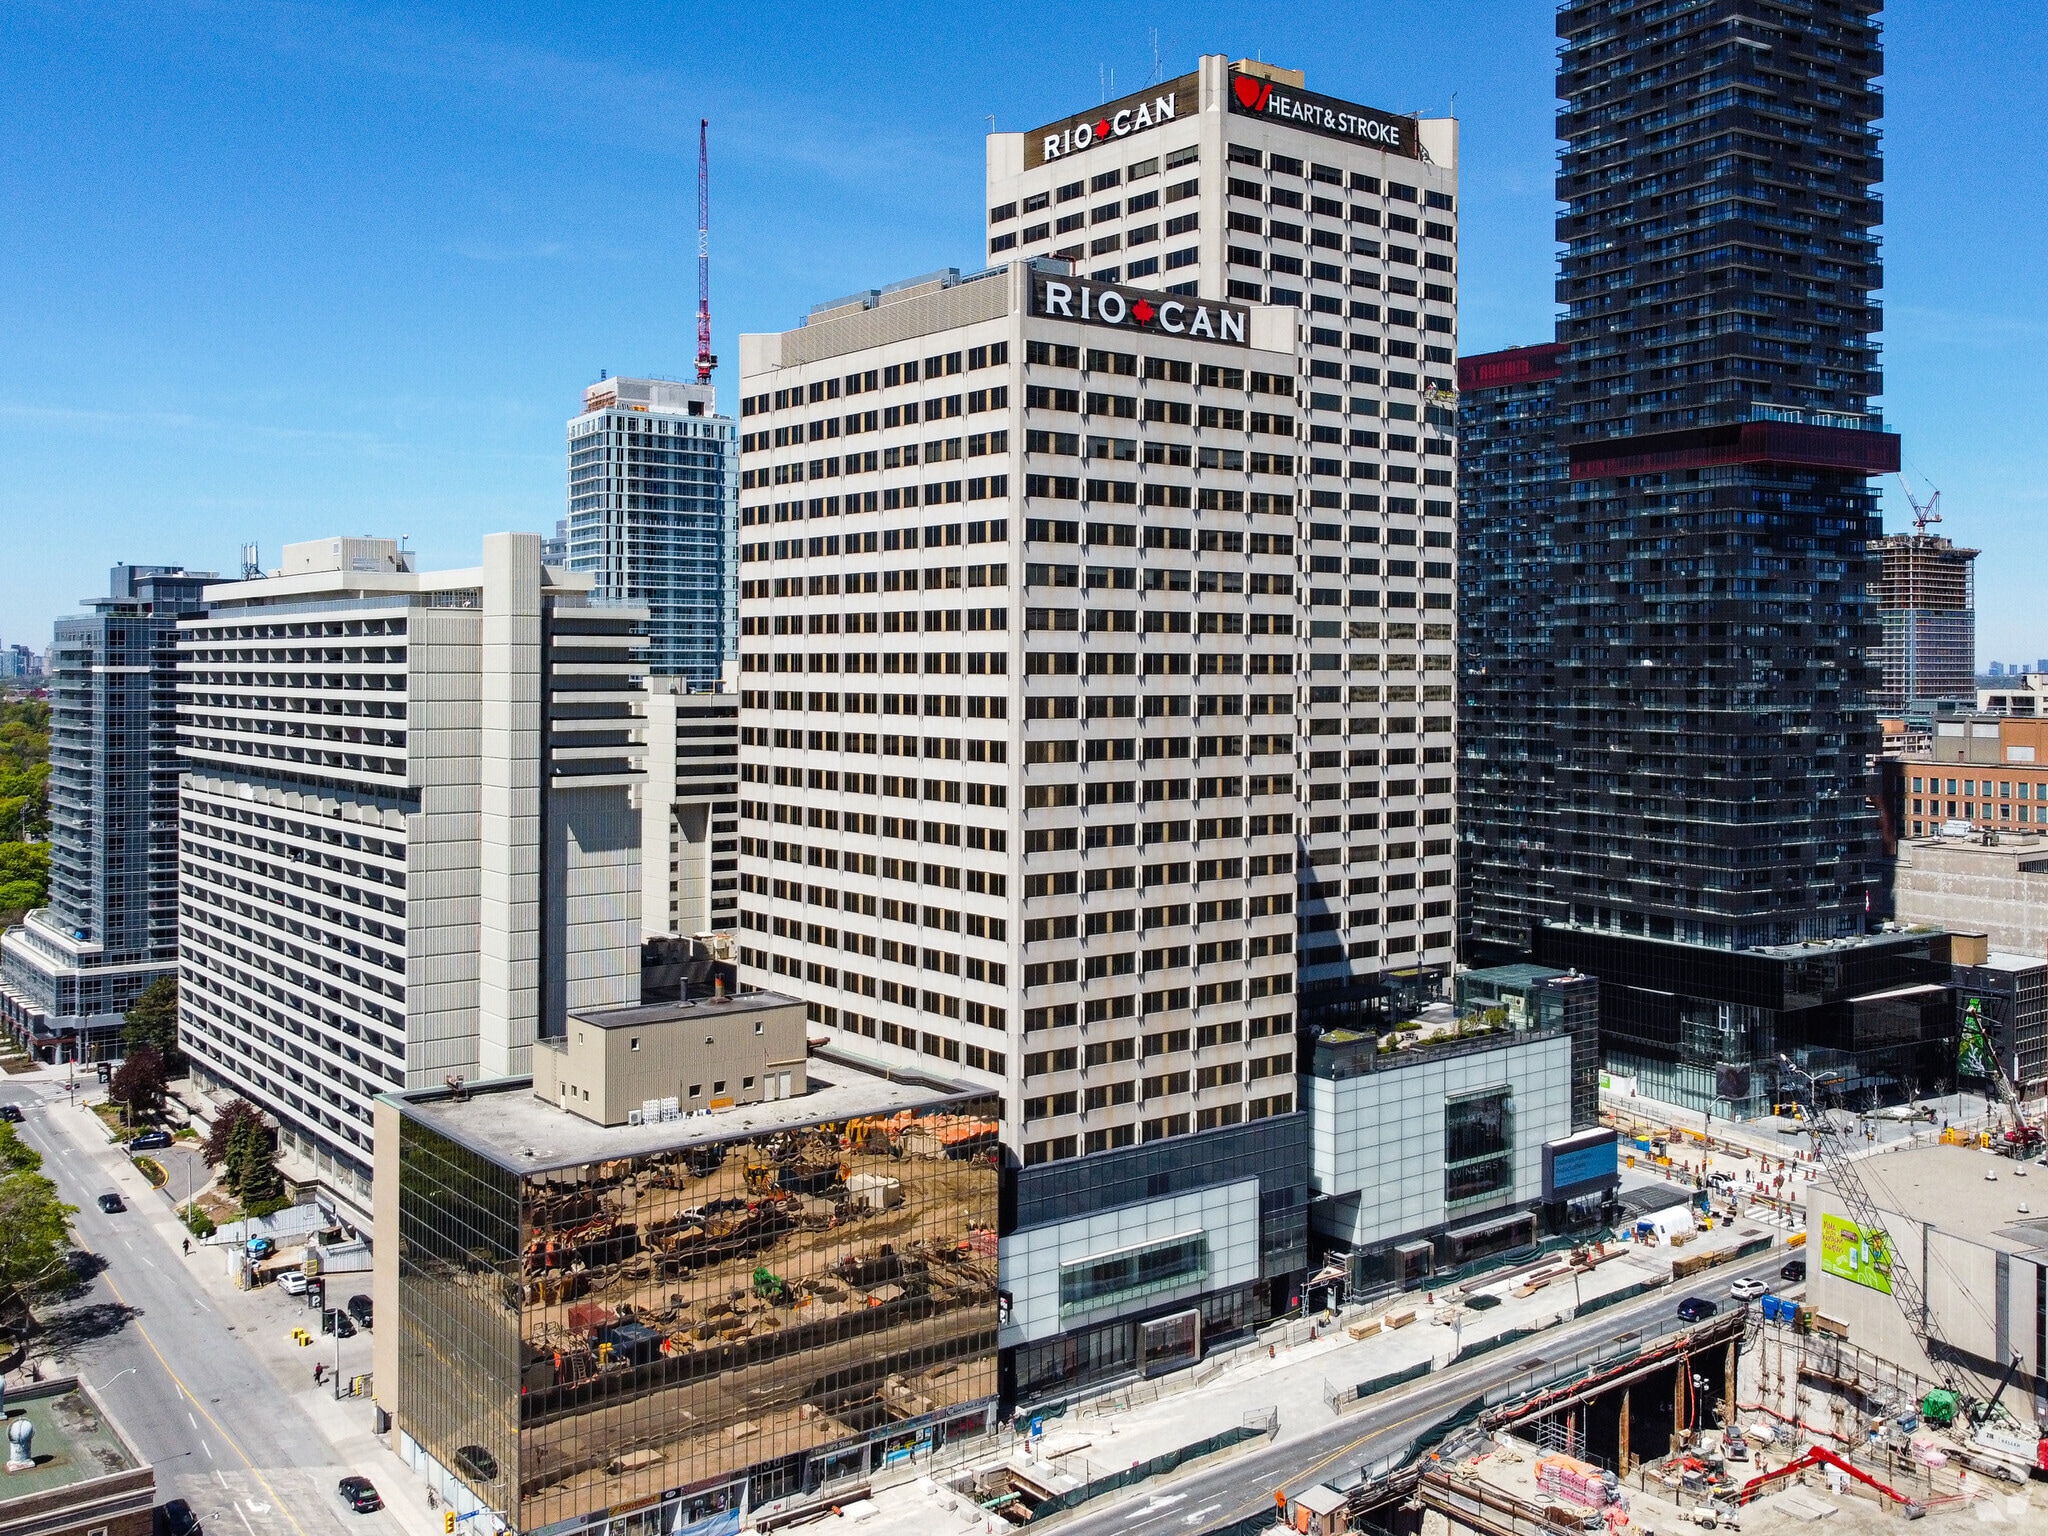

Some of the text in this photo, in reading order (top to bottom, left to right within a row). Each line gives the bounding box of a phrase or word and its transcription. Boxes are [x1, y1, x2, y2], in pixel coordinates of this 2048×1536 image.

[1044, 92, 1176, 161] RIO CAN
[1045, 280, 1245, 343] RIO CAN
[1452, 1160, 1499, 1179] WINNERS
[827, 1443, 838, 1452] UPS
[839, 1440, 853, 1449] Store
[619, 1495, 657, 1512] CONVENIENCE
